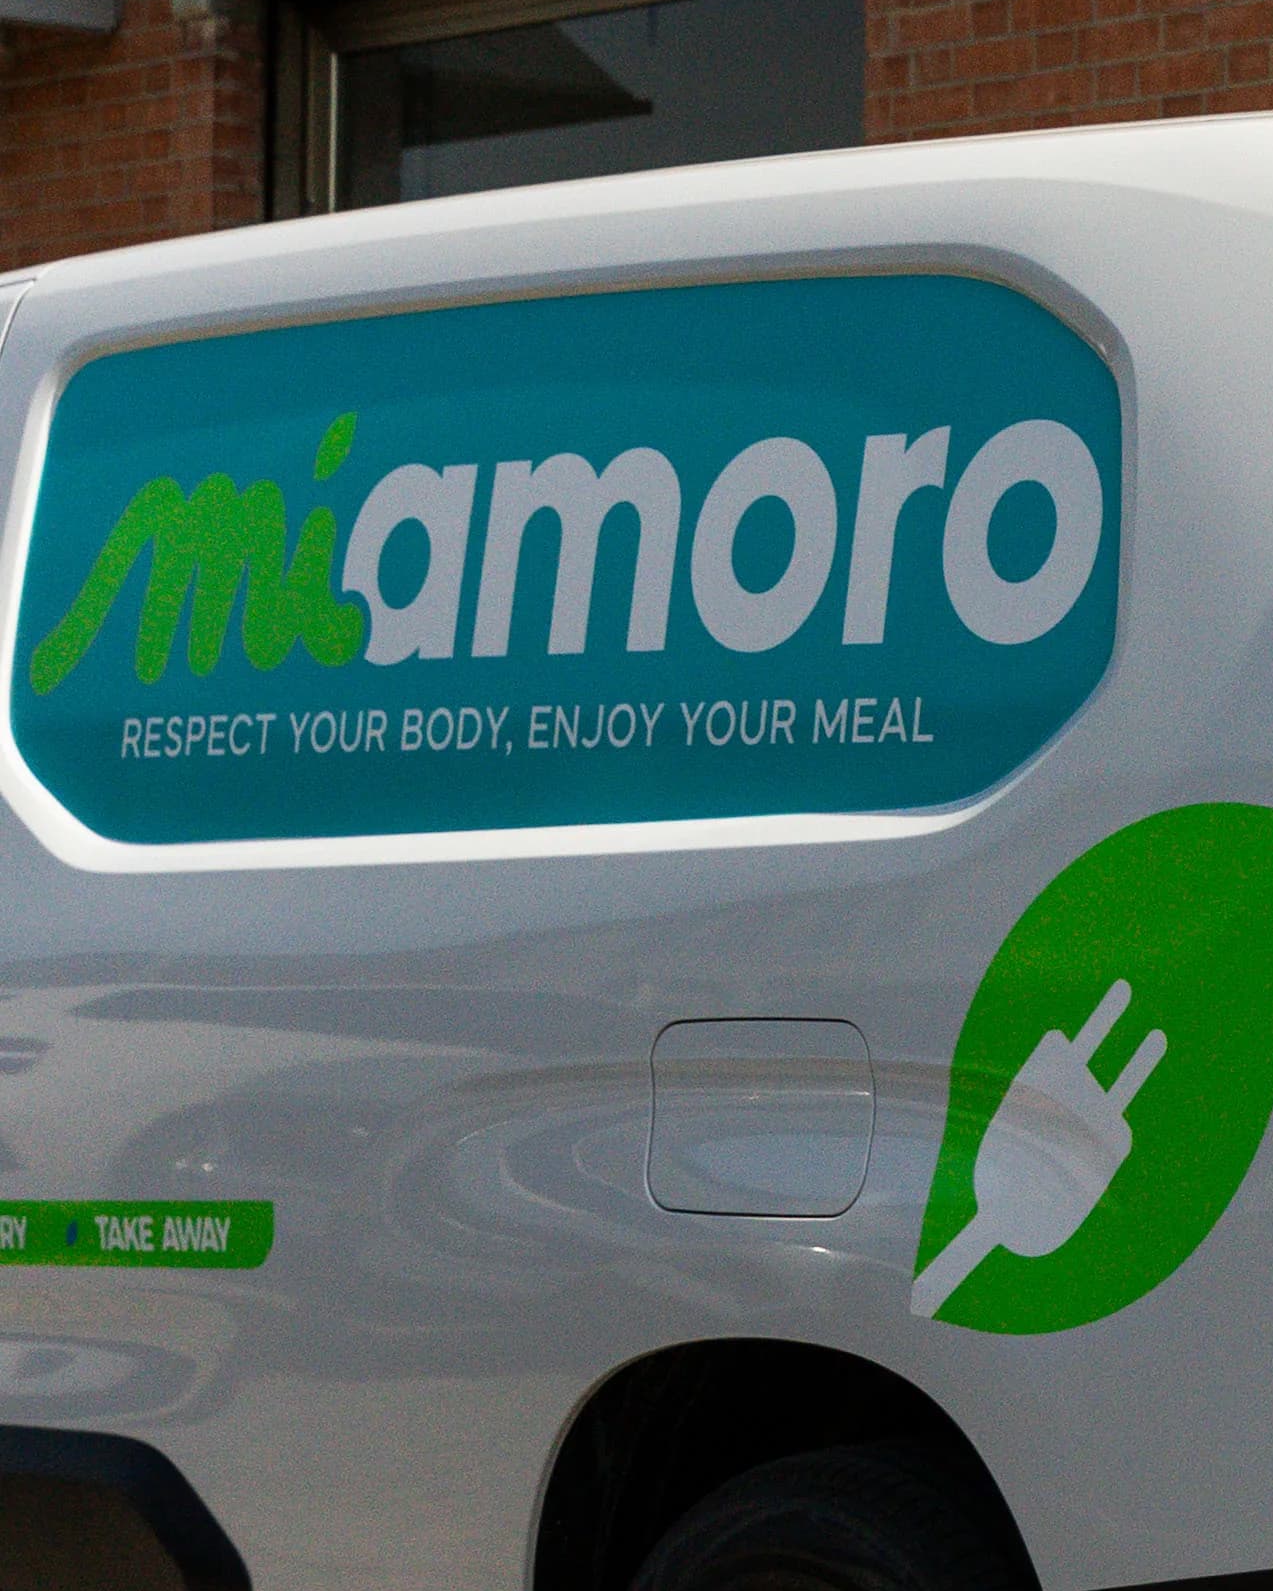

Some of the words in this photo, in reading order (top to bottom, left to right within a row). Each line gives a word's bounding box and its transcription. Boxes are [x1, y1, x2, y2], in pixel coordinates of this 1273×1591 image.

[30, 411, 1103, 695] miamoro
[121, 714, 277, 758] RESPECT
[289, 710, 388, 753] YOUR
[401, 707, 513, 755] BODY,
[528, 703, 664, 749] ENJOY
[680, 699, 797, 746] YOUR
[812, 697, 934, 744] MEAL
[94, 1216, 154, 1251] TAKE
[163, 1216, 231, 1251] AWAY
